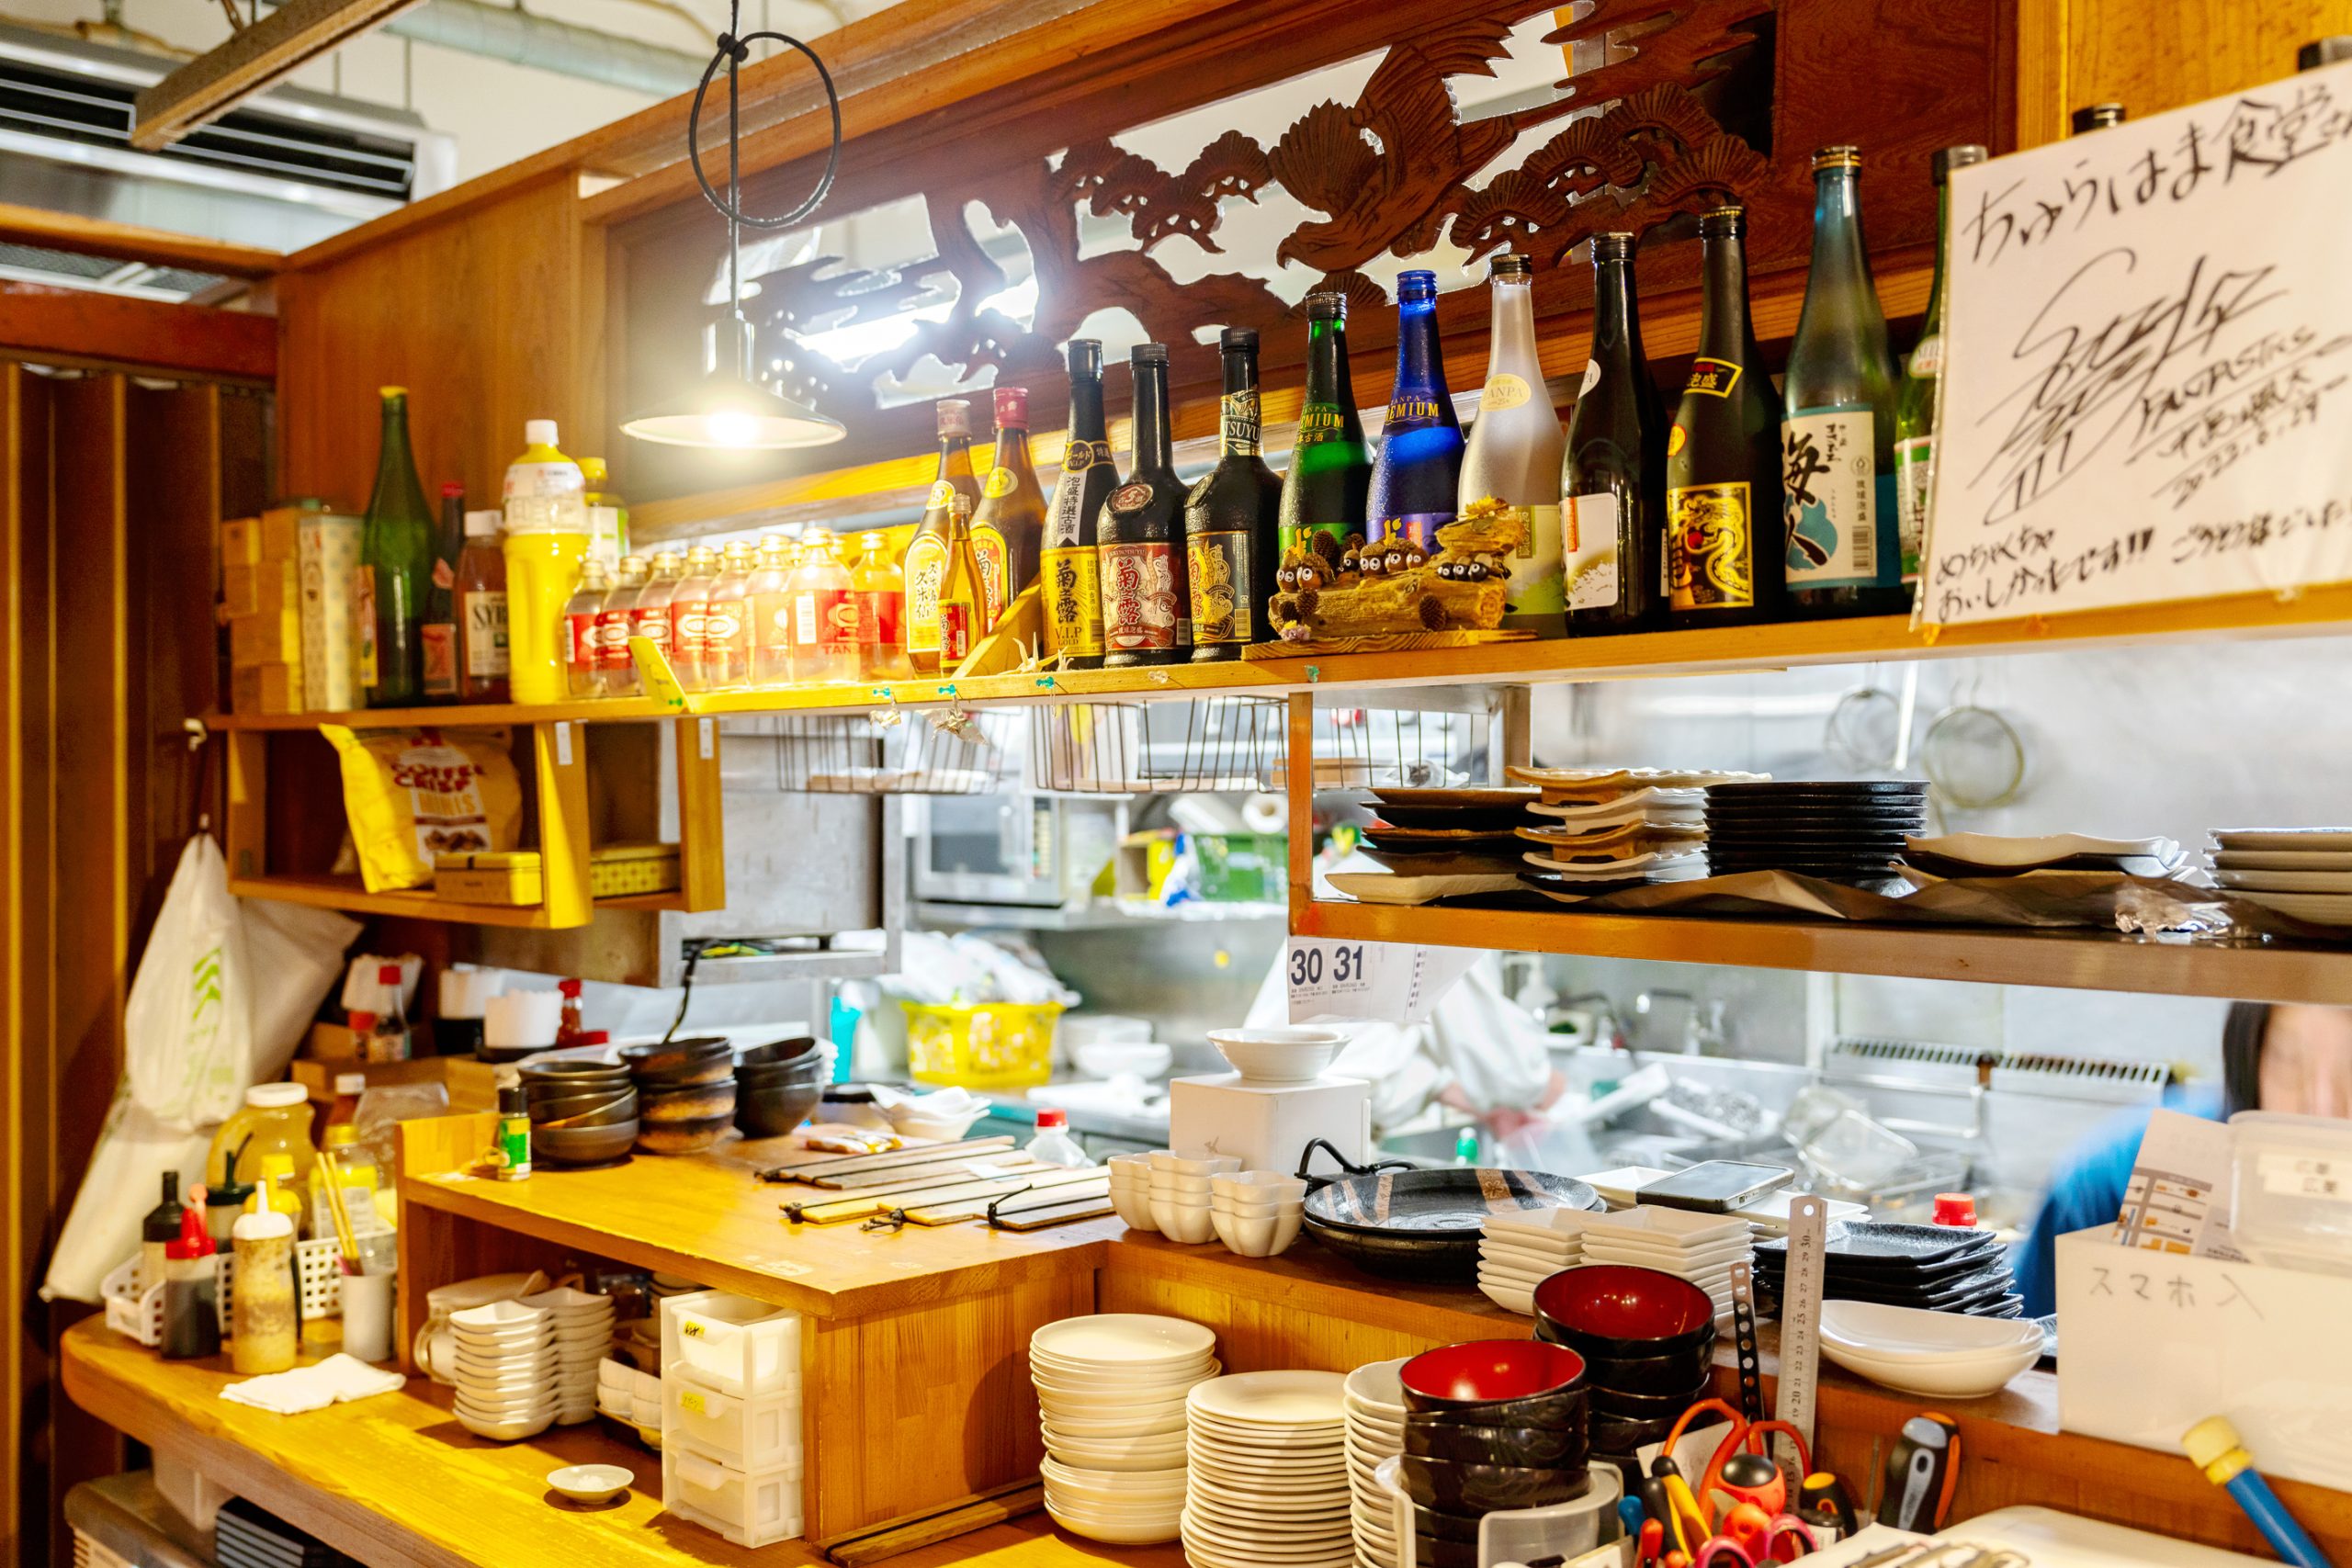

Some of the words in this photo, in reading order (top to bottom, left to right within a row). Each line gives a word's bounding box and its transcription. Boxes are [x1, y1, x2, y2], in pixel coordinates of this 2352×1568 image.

[1291, 949, 1323, 986] 30
[1333, 945, 1363, 982] 31
[1801, 1235, 1811, 1248] 30
[1797, 1313, 1806, 1325] 25
[1792, 1391, 1802, 1404] 20
